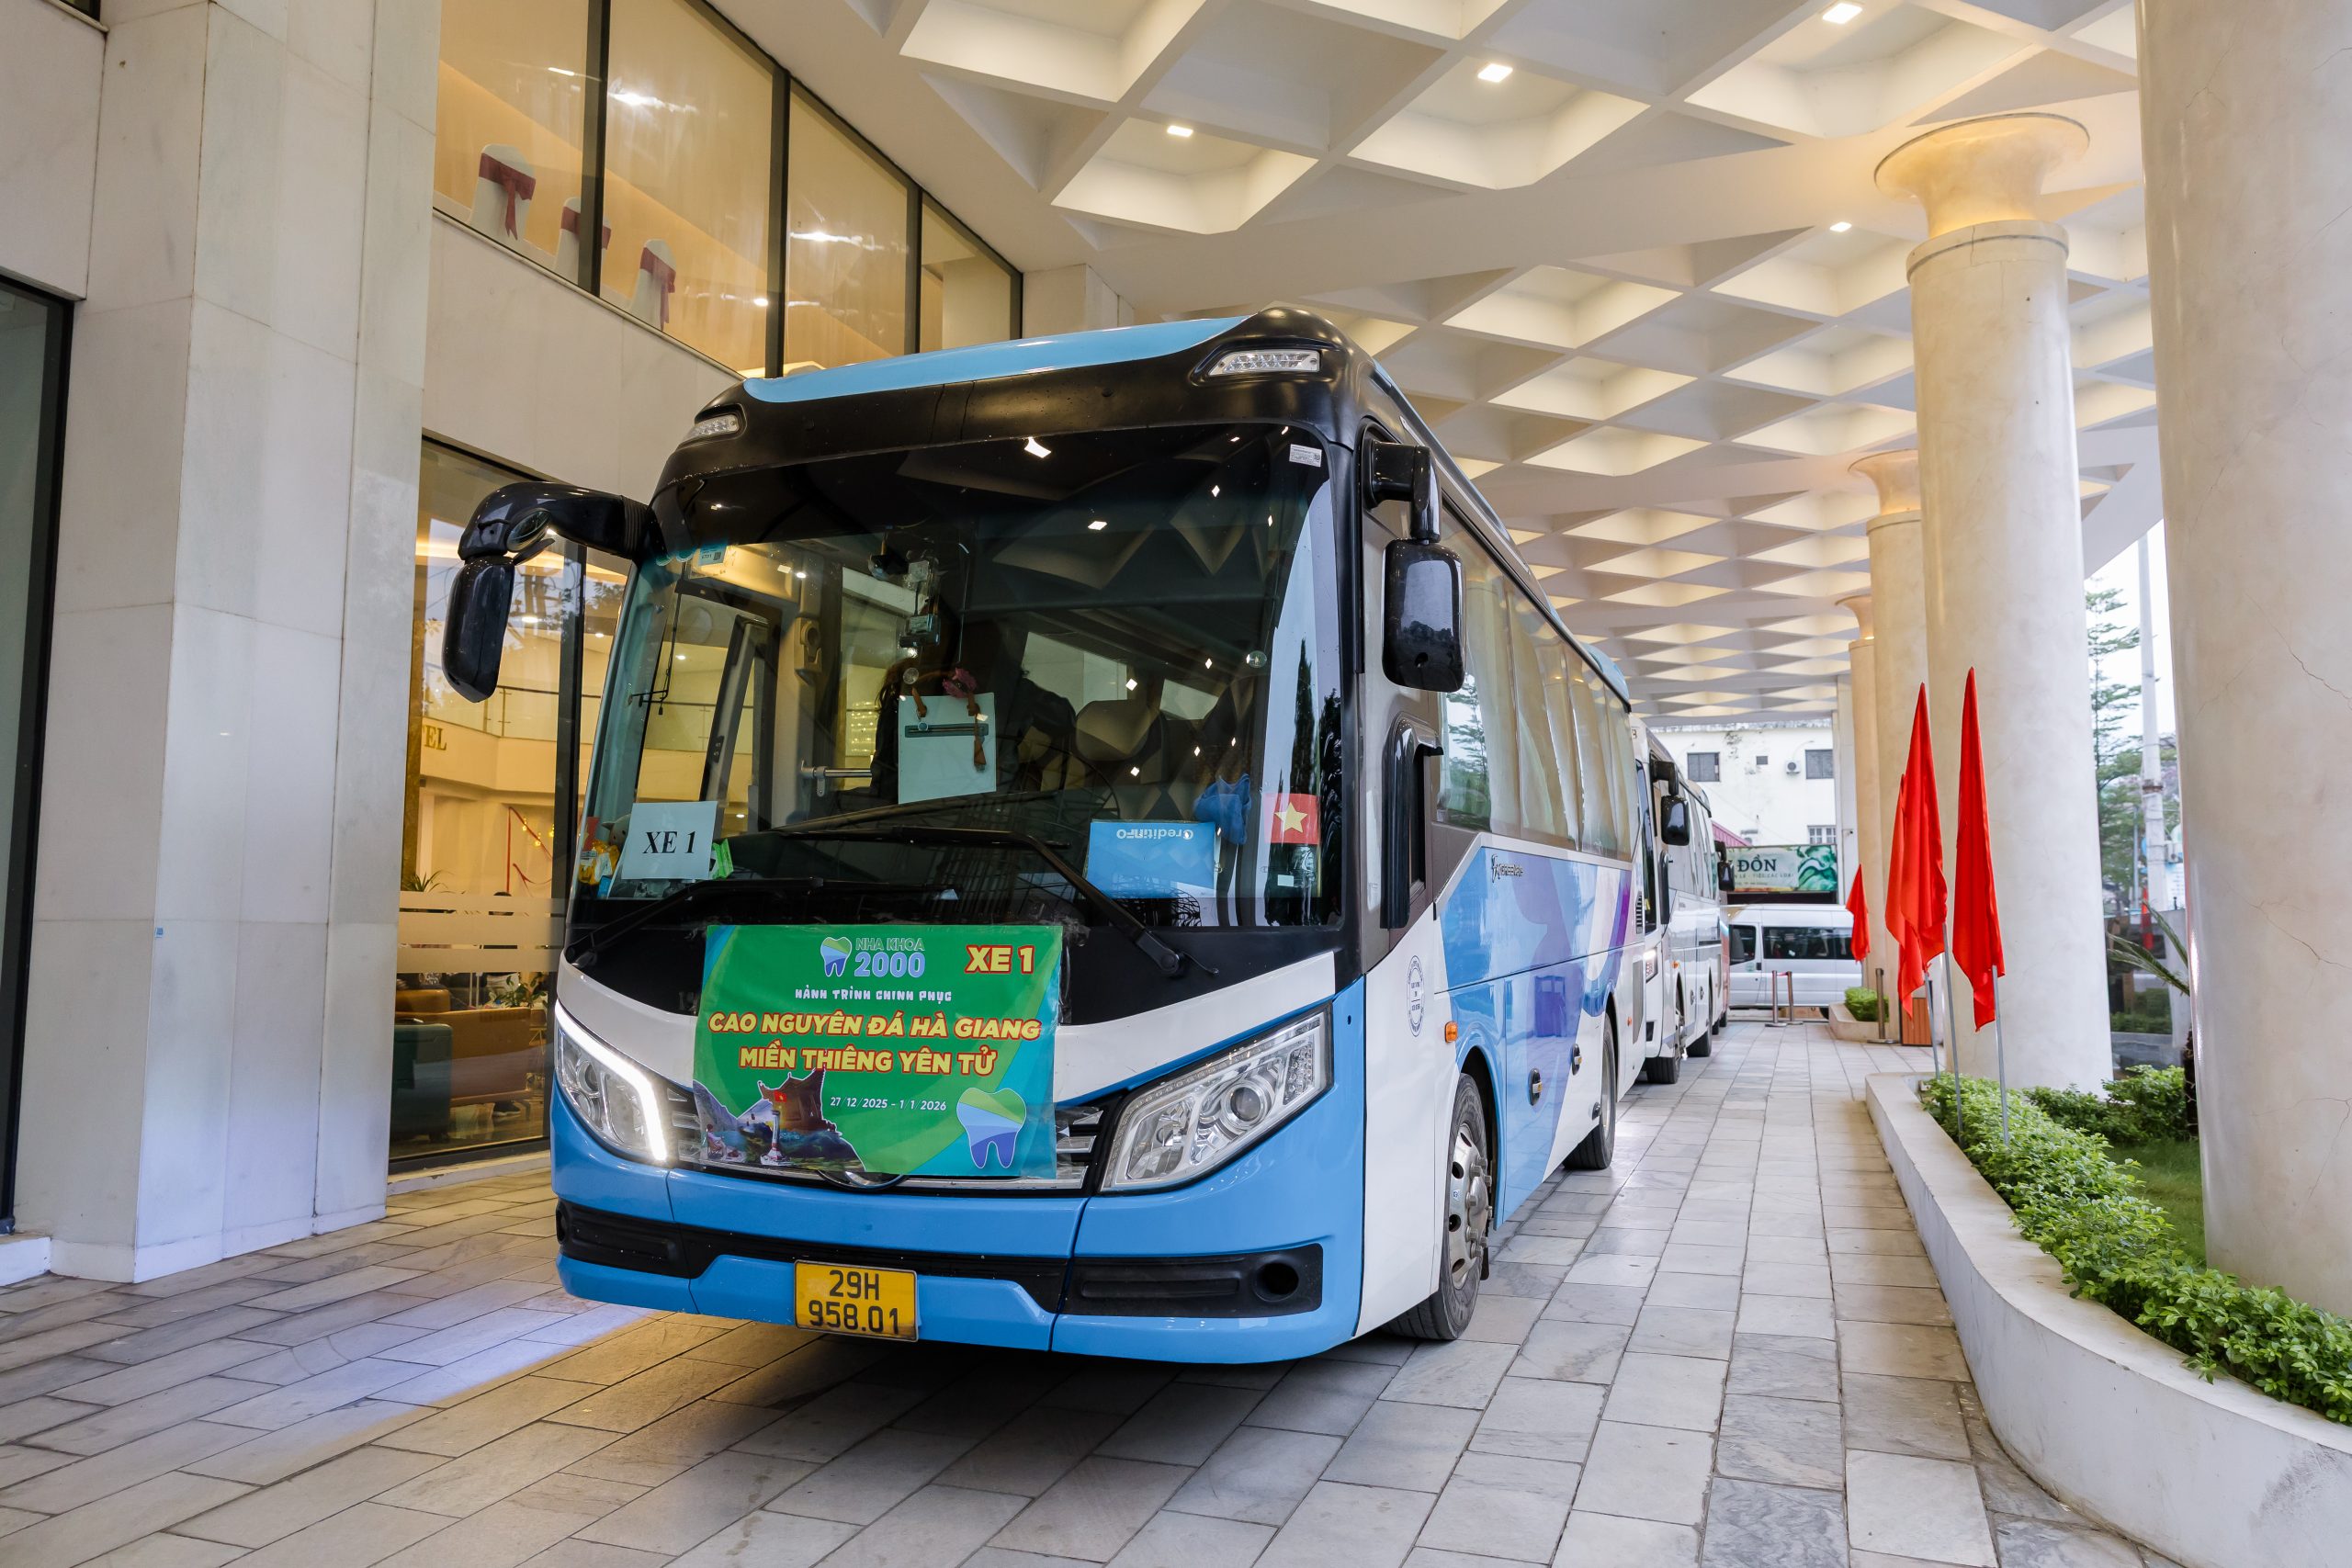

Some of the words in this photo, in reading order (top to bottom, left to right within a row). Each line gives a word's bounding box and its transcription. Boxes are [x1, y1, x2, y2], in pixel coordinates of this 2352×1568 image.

[423, 725, 447, 750] EL
[642, 831, 678, 854] XE
[684, 830, 696, 854] 1
[1737, 854, 1777, 872] ĐỒN
[855, 937, 884, 951] NHA
[887, 937, 925, 951] KHOA
[854, 952, 925, 977] 2000
[965, 944, 1012, 974] XE
[1018, 945, 1035, 974] 1
[876, 990, 914, 1000] CHINH
[919, 990, 952, 1005] PHỤC
[708, 1011, 758, 1032] CAO
[761, 1009, 864, 1035] NGUYÊN
[866, 1010, 905, 1036] ĐÁ
[909, 1011, 948, 1038] HÀ
[954, 1017, 1042, 1041] GIANG
[739, 1039, 797, 1068] MIỀN
[800, 1043, 893, 1073] THIÊNG
[898, 1045, 952, 1075] YÊN
[957, 1044, 998, 1077] TỬ
[830, 1097, 888, 1109] 27/12/2025
[829, 1269, 879, 1301] 29H
[808, 1300, 899, 1335] 958.01
